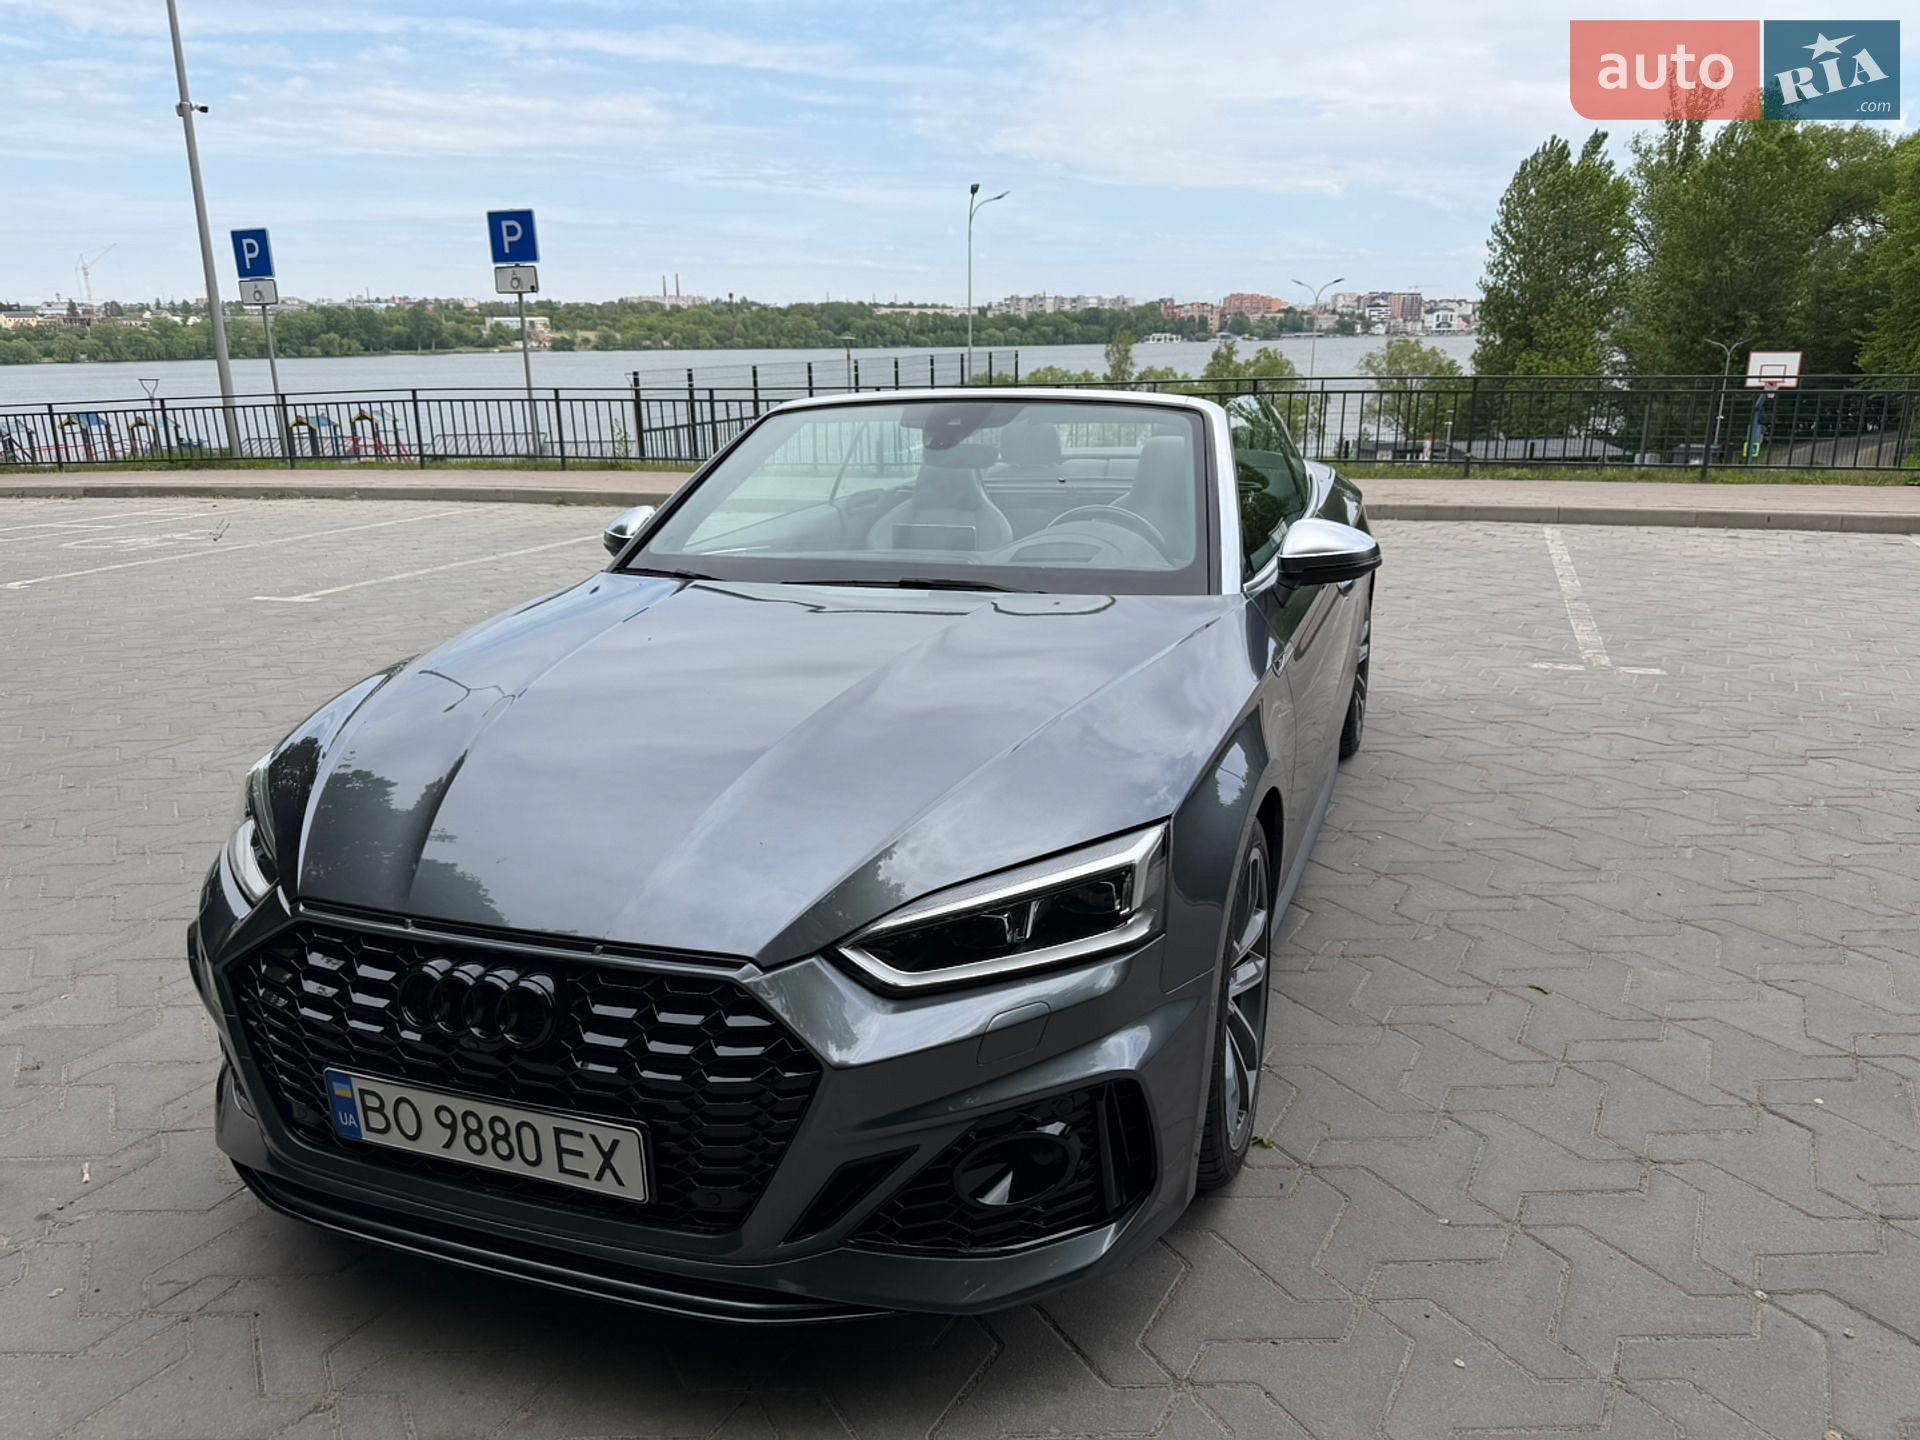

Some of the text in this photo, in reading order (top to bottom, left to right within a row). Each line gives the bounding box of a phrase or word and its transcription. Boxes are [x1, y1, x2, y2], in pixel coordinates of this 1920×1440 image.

[501, 220, 523, 254] P
[241, 238, 260, 269] P
[338, 1110, 359, 1128] UA
[358, 1087, 625, 1187] BO 9880 EX
